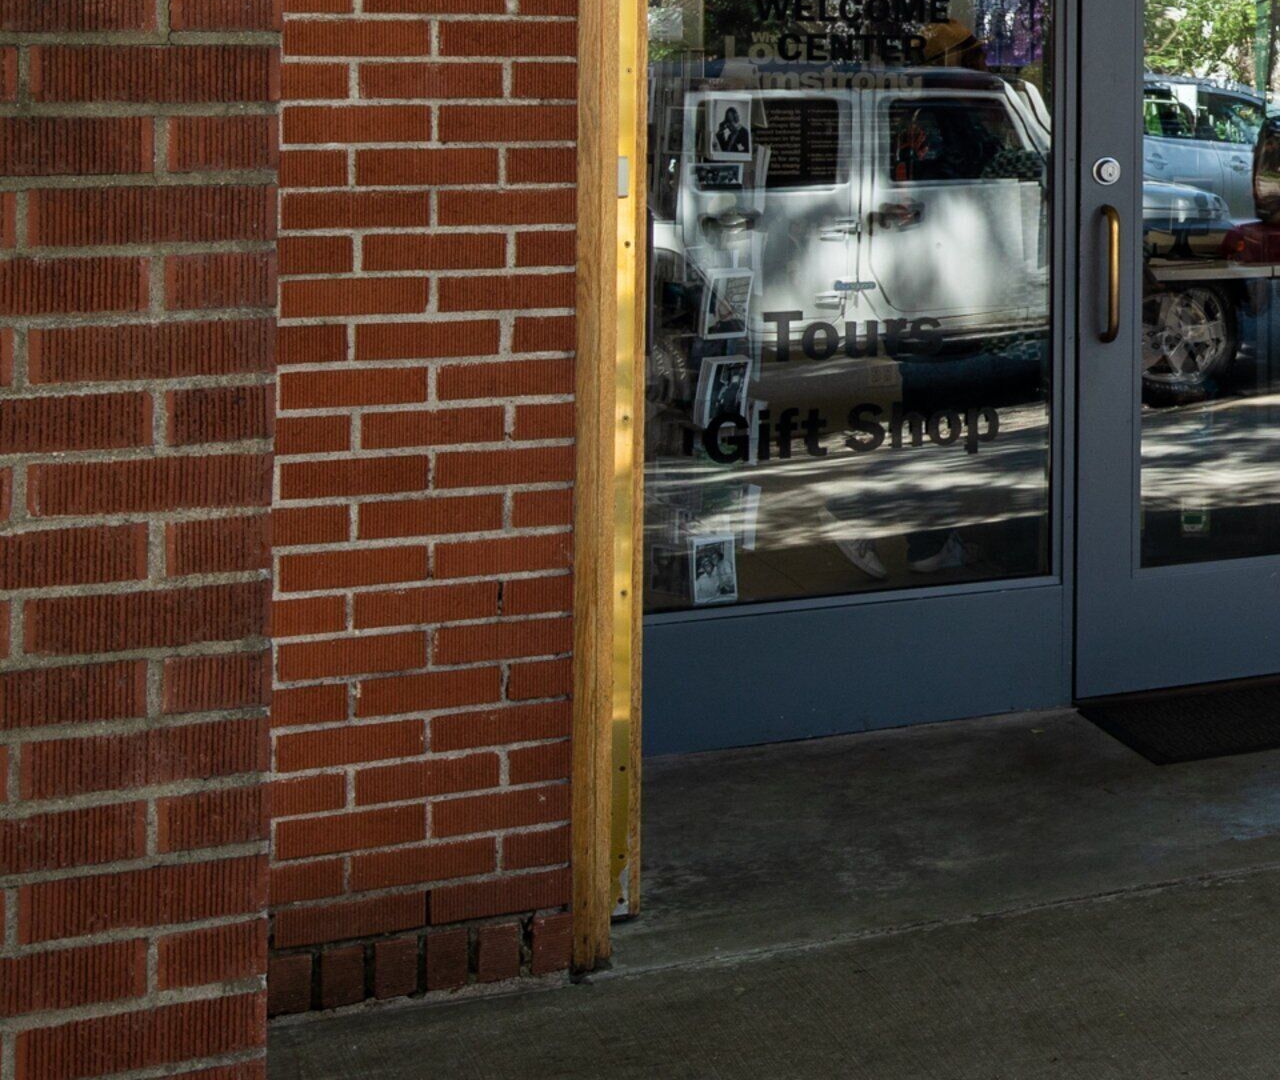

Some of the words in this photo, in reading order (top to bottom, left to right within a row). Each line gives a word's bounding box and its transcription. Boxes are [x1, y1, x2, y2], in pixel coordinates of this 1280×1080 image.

[778, 33, 927, 65] CENTER
[763, 310, 944, 362] Tours
[703, 407, 828, 464] Gift
[845, 401, 1000, 455] Shop
